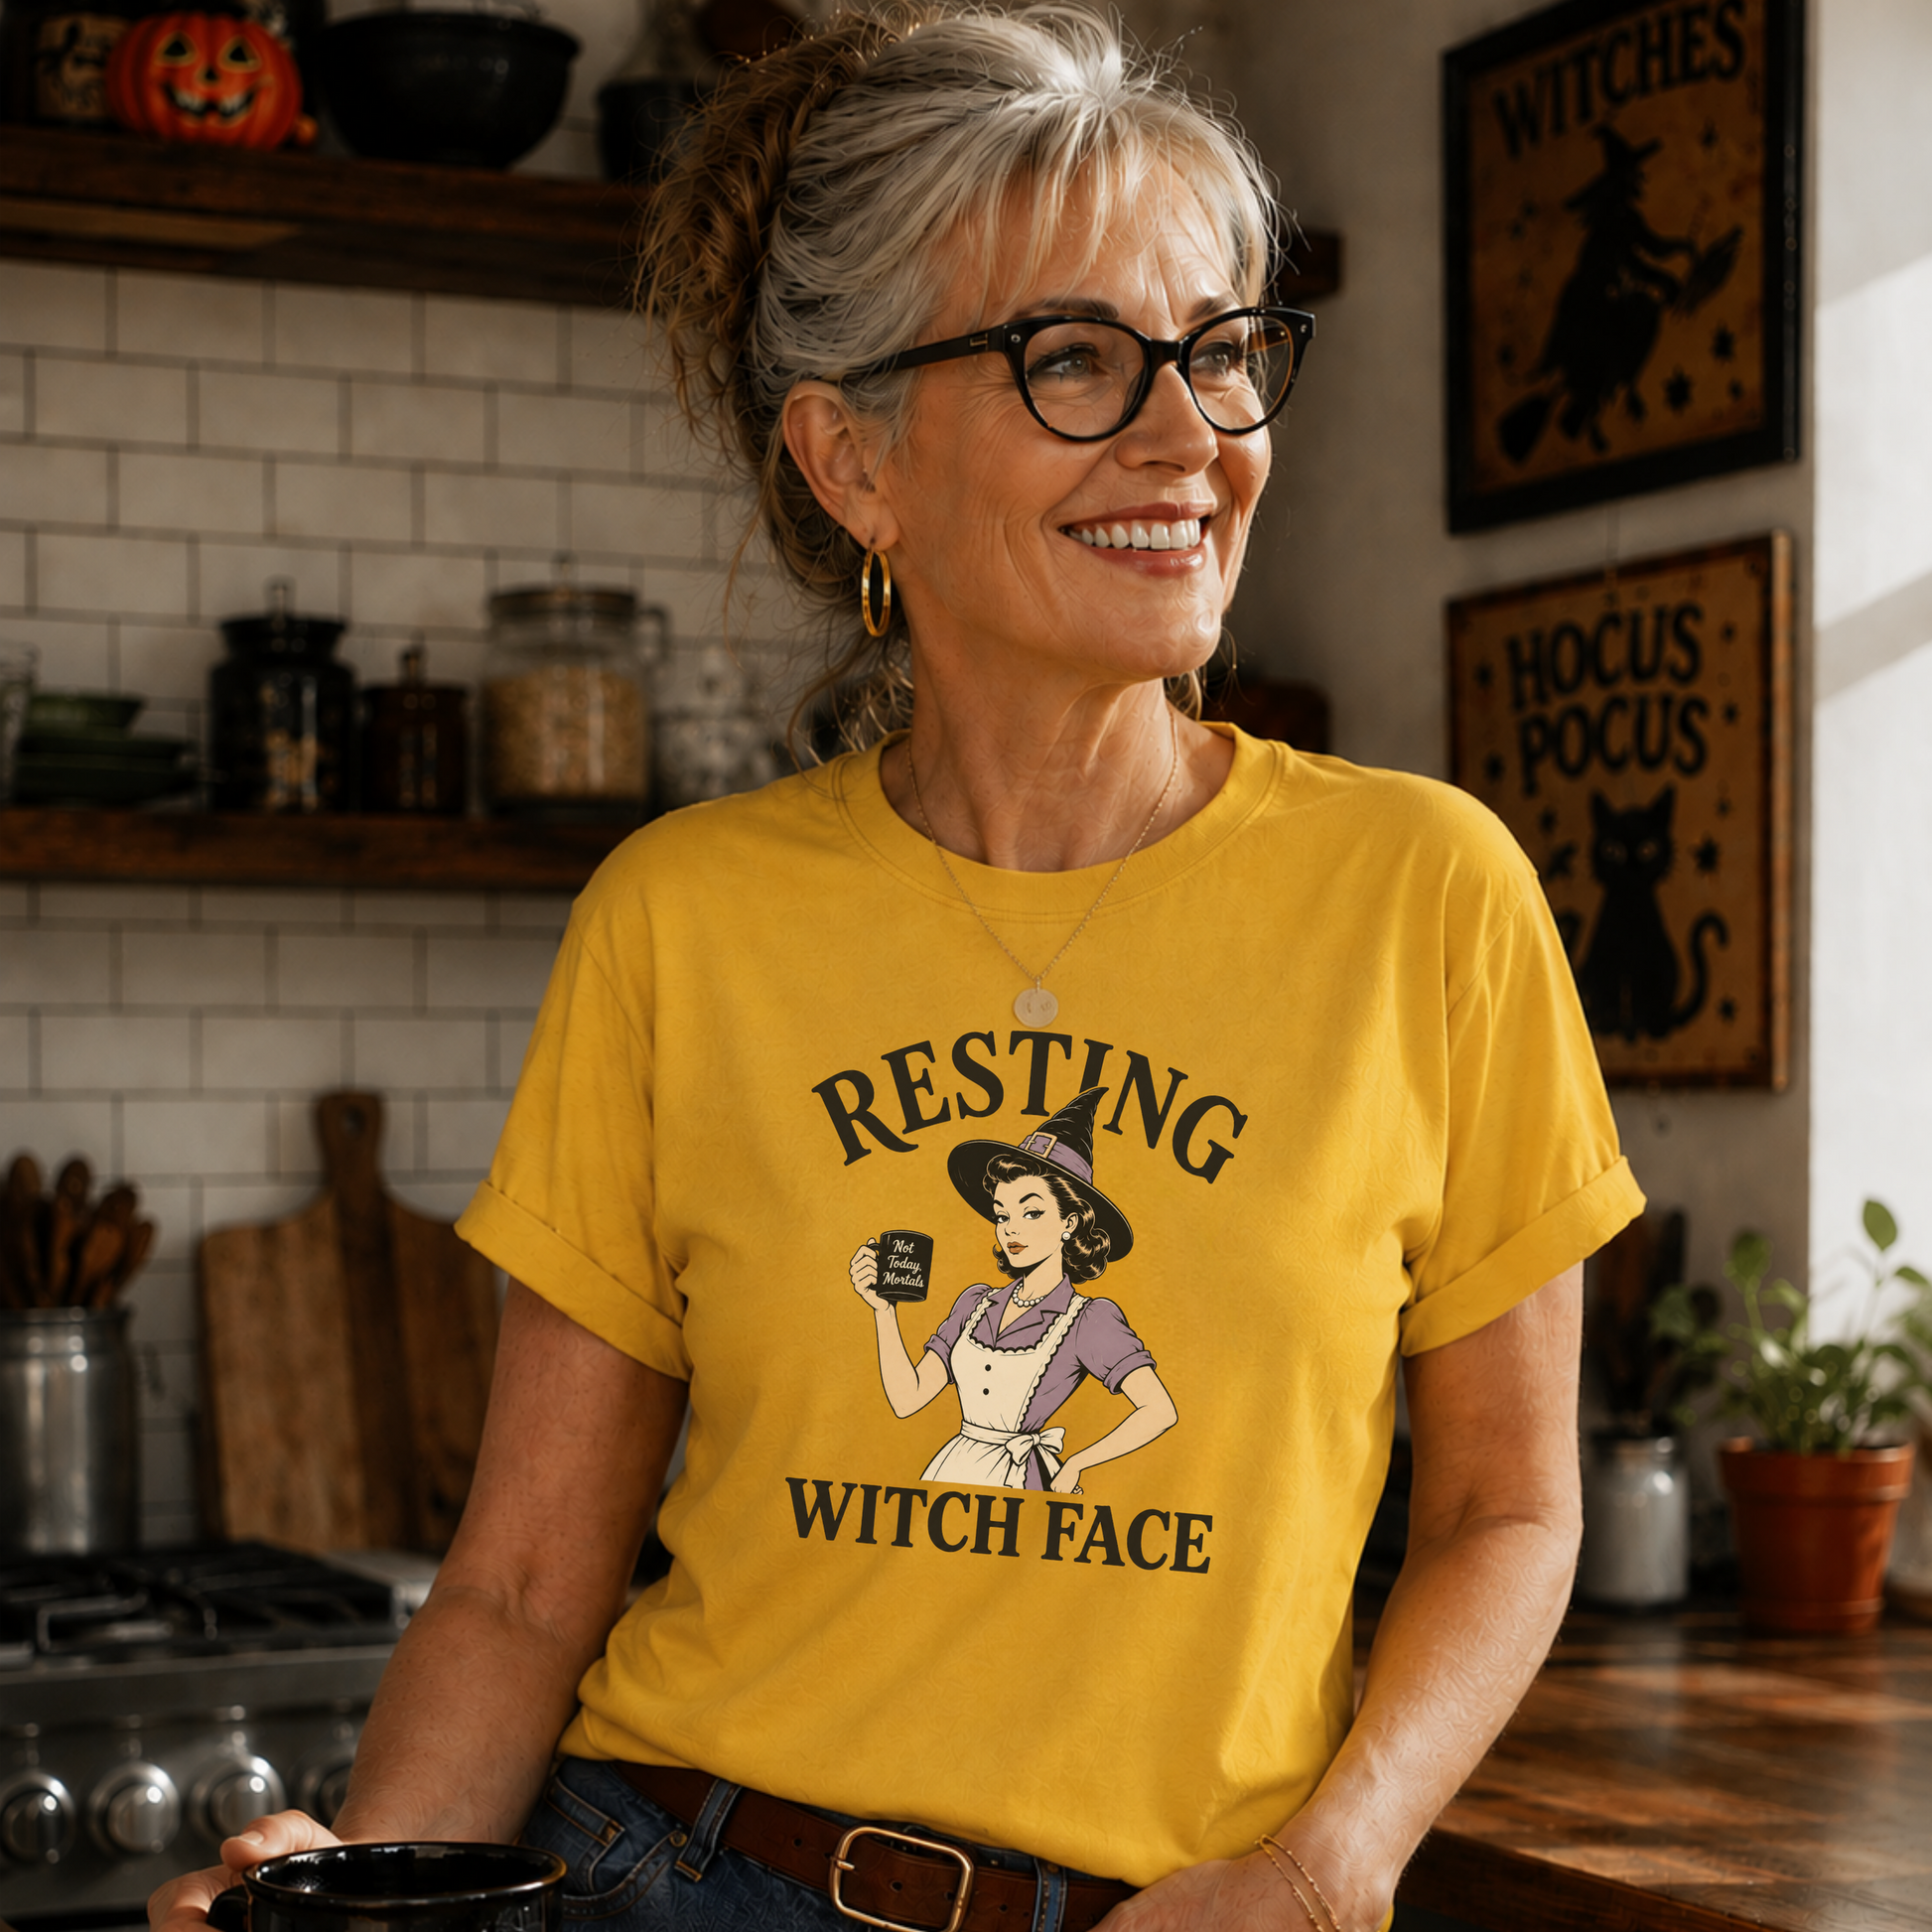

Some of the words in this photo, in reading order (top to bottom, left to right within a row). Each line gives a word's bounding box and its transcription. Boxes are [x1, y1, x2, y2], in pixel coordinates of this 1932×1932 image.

[1492, 0, 1744, 159] WITCHES
[1507, 603, 1703, 712] HOCUS
[1519, 694, 1711, 795] POCUS
[811, 1031, 1248, 1184] RESTING
[883, 1272, 924, 1288] Mortals
[893, 1239, 914, 1254] Not
[785, 1477, 1025, 1558] WITCH
[1040, 1500, 1213, 1575] FACE
